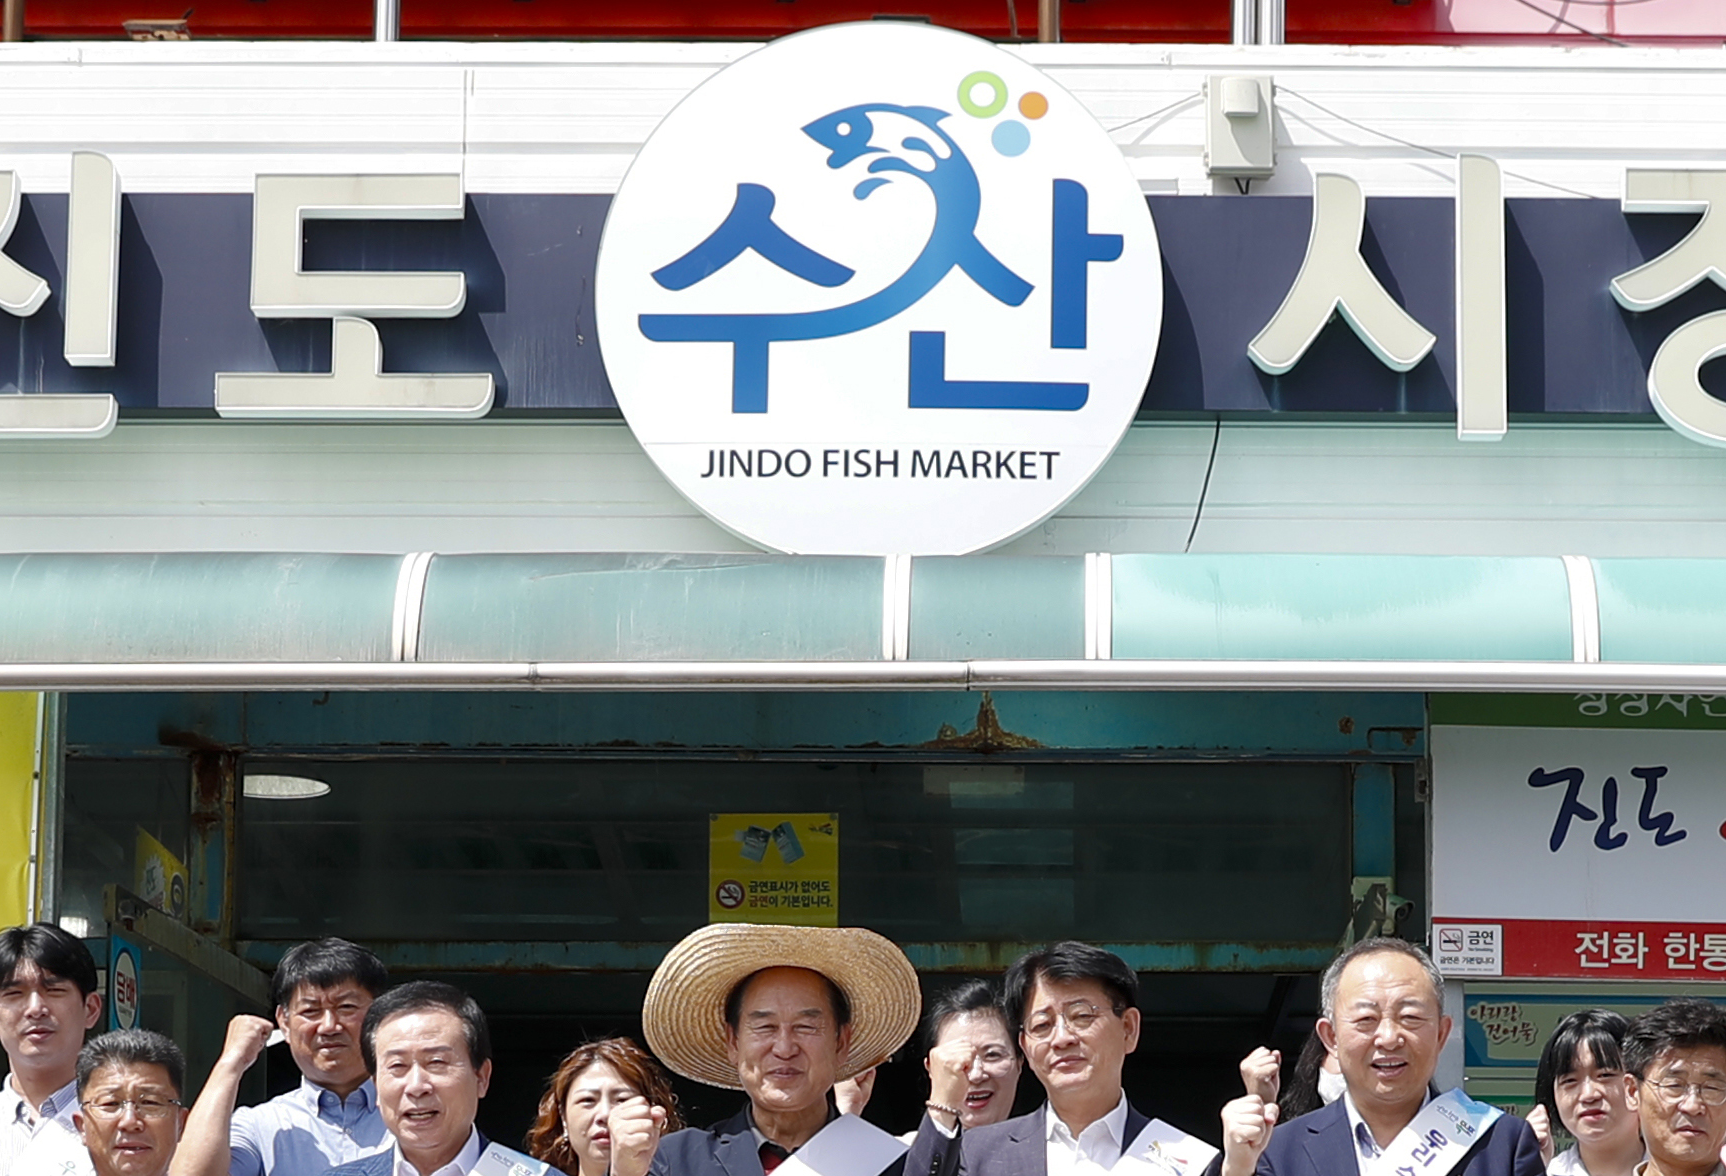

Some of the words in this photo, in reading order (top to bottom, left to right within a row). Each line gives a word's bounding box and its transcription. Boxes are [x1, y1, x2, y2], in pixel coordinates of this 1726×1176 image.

[638, 118, 1125, 414] 수산
[700, 448, 813, 480] JINDO
[822, 448, 900, 479] FISH
[910, 449, 1062, 481] MARKET
[1527, 764, 1688, 852] 진도
[748, 880, 799, 894] 금연표시가
[800, 880, 831, 893] 없어도
[748, 895, 779, 908] 금연이
[780, 895, 834, 908] 기본입니다.
[1467, 930, 1494, 946] 금연
[1574, 930, 1649, 969] 전화
[1410, 1127, 1449, 1168] 우리
